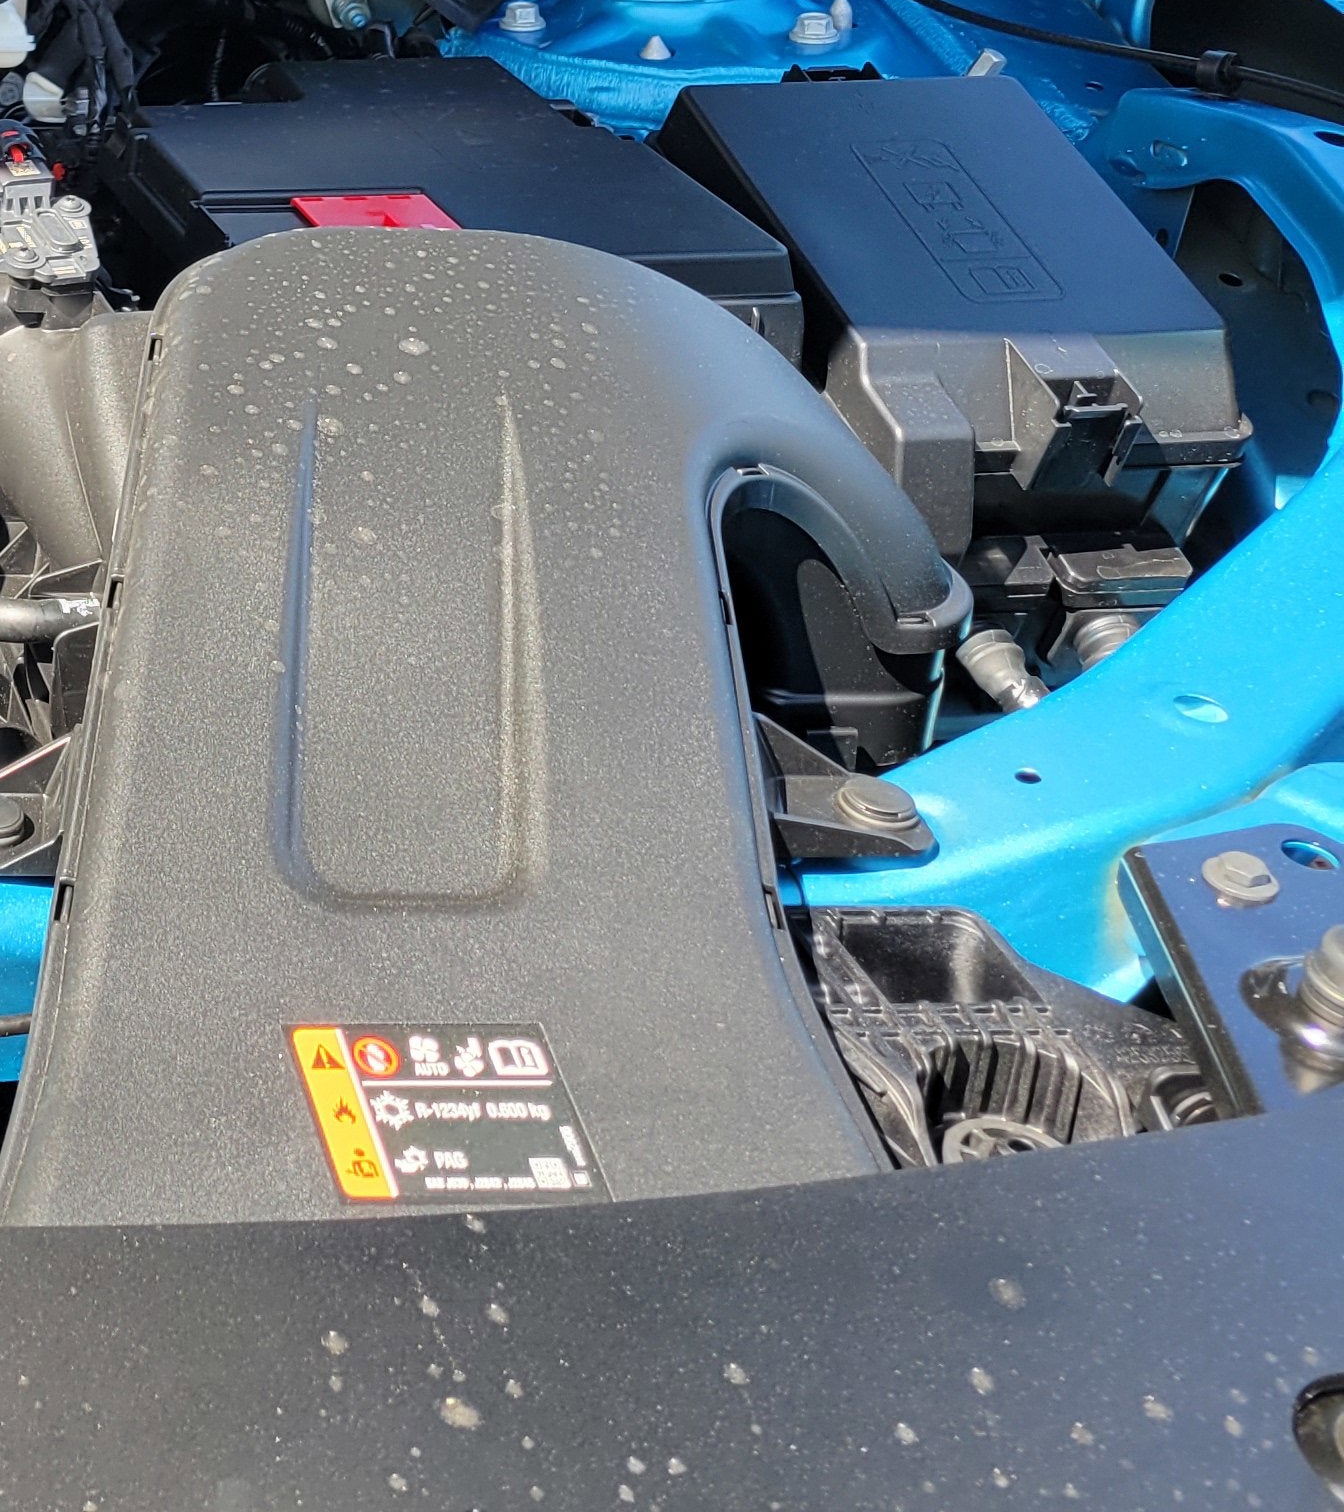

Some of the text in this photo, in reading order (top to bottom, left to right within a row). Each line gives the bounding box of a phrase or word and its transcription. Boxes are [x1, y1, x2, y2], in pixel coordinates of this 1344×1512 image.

[415, 1062, 449, 1076] AUTO
[527, 1102, 551, 1121] kg
[434, 1151, 468, 1169] PAG
